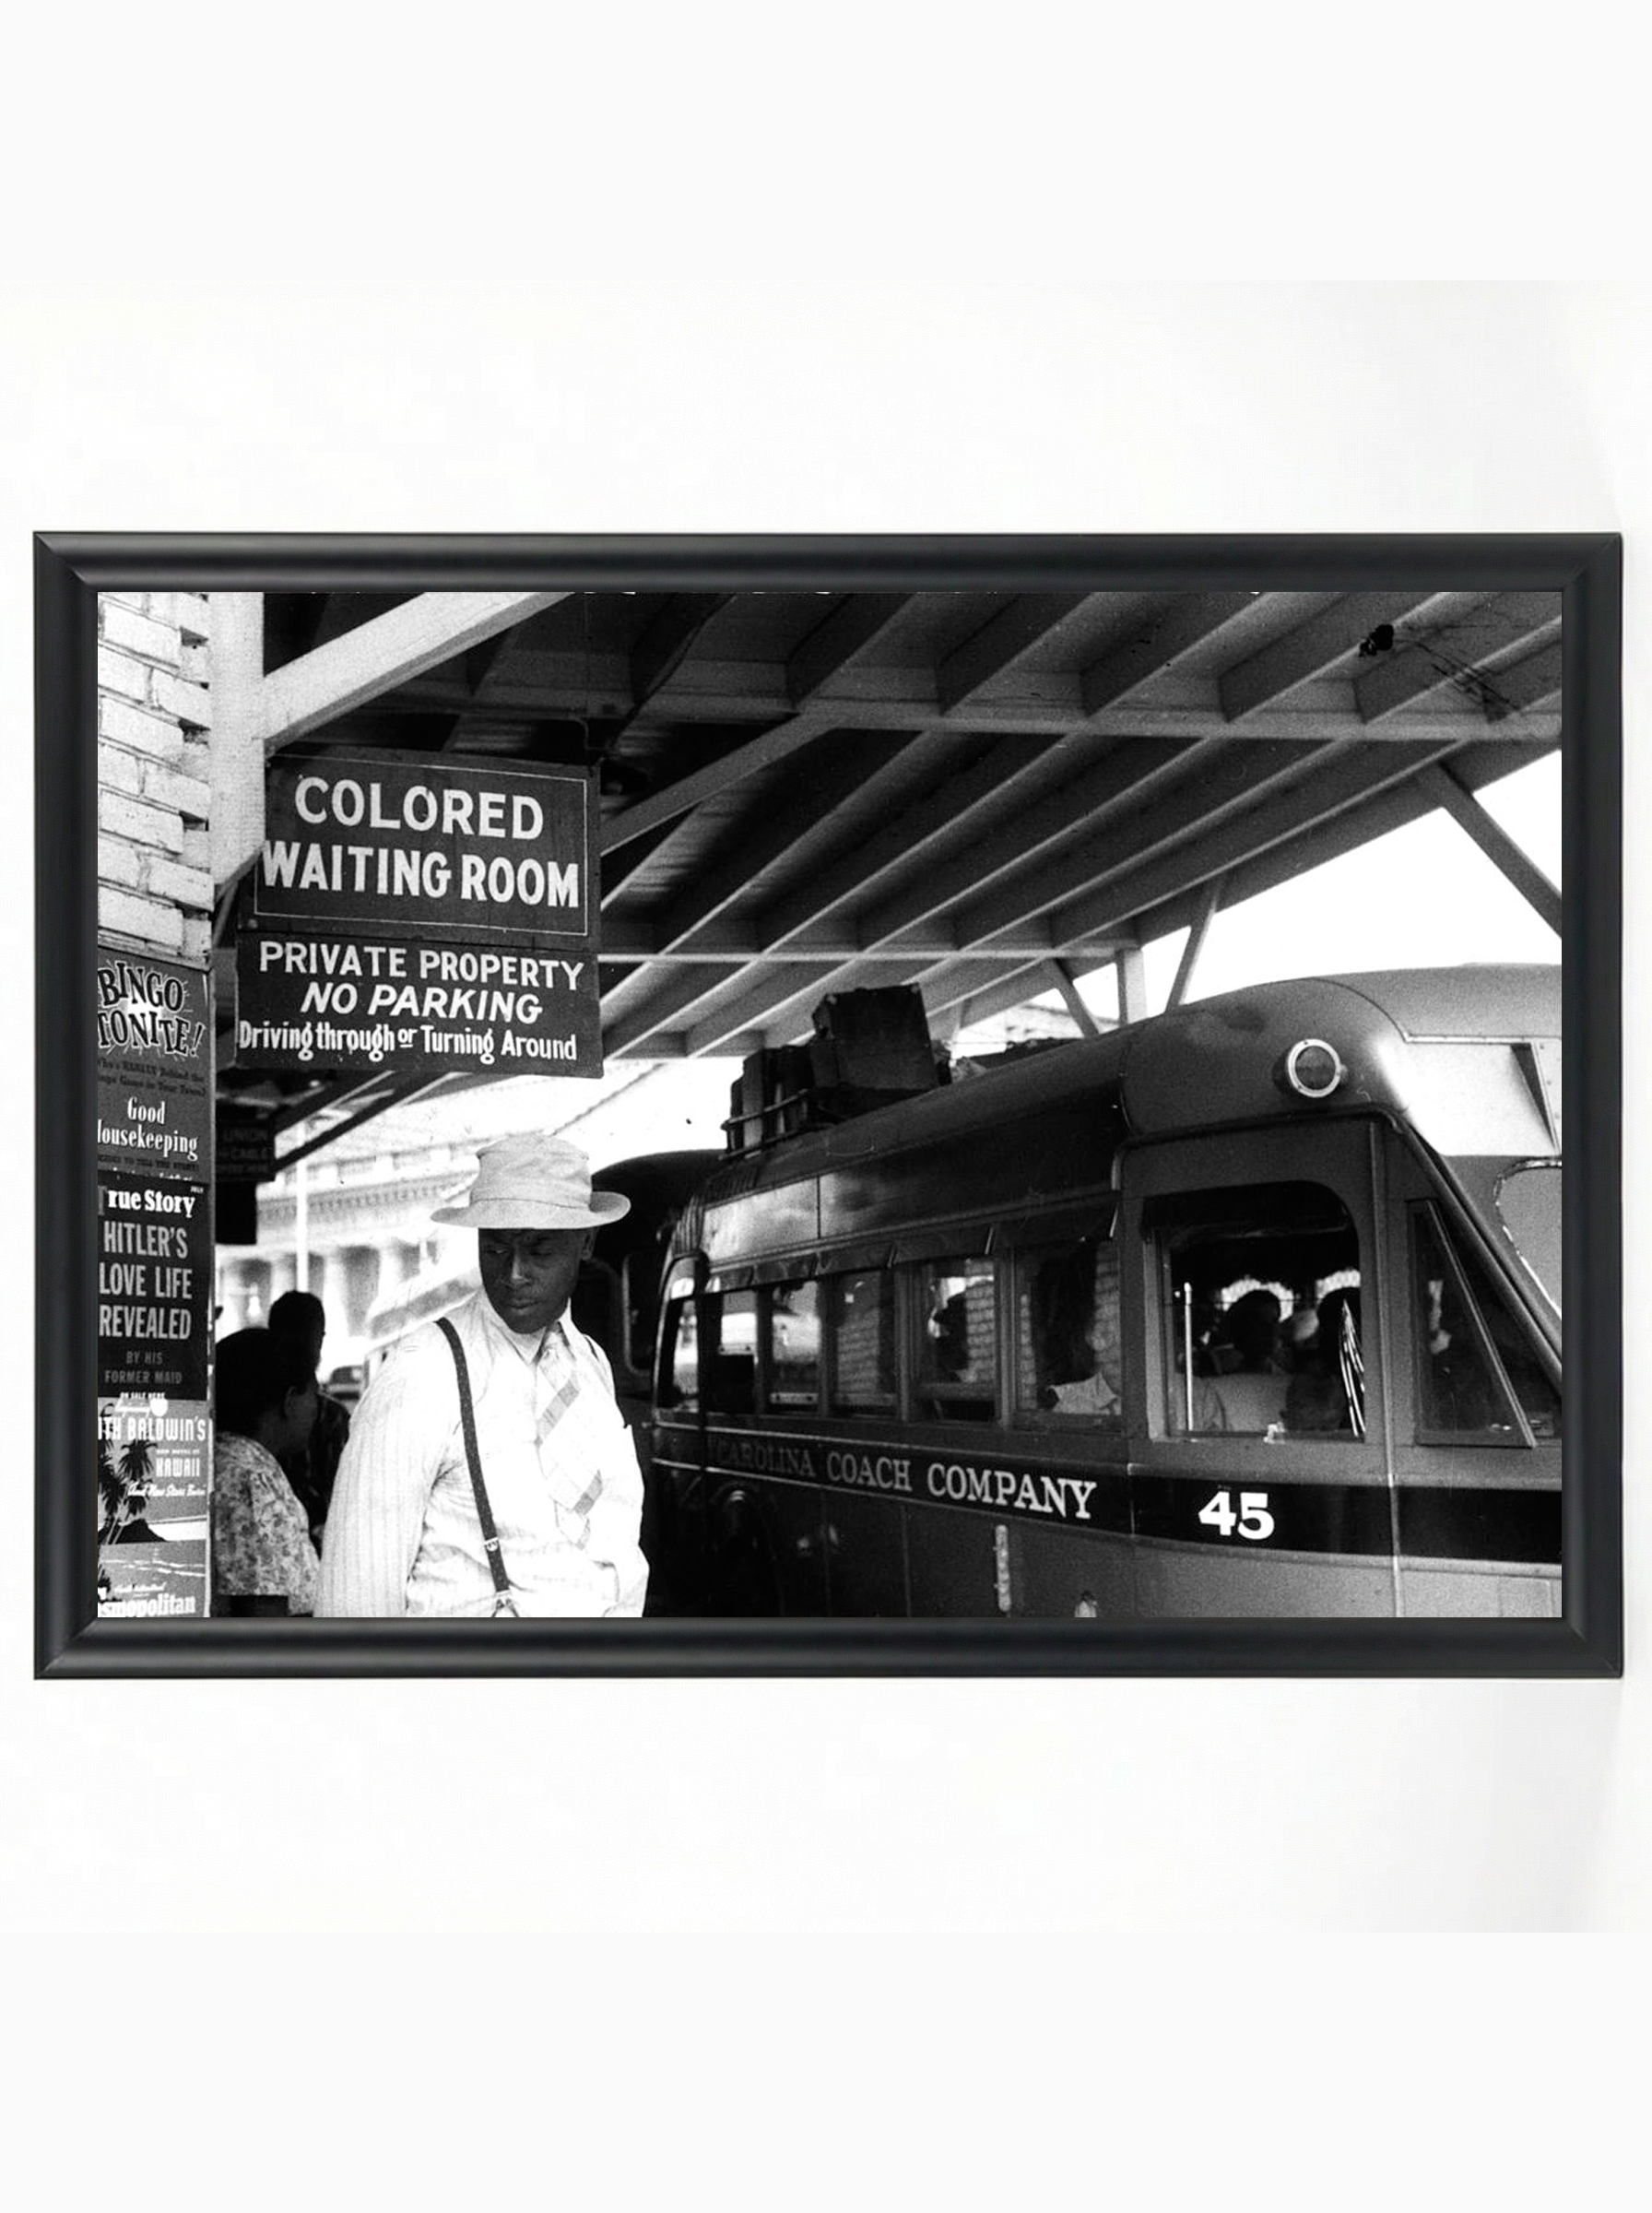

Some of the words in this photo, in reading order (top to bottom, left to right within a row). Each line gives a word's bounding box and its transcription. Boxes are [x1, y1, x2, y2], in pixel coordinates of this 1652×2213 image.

[294, 775, 544, 840] COLORED
[262, 840, 452, 898] WAITING
[460, 854, 579, 908] ROOM
[259, 941, 407, 977] PRIVATE
[419, 949, 584, 990] PROPERTY
[98, 960, 185, 1012] BINGO
[300, 982, 358, 1013] NO
[368, 984, 543, 1024] PARKING
[98, 1009, 206, 1057] TONITE!
[239, 1021, 313, 1061] Driving
[317, 1023, 395, 1062] through
[397, 1027, 418, 1048] or
[420, 1025, 495, 1065] Turning
[501, 1035, 577, 1060] Around
[127, 1096, 166, 1124] Good
[144, 1189, 195, 1218] Story
[103, 1220, 188, 1259] HITLER'S
[99, 1261, 147, 1296] LOVE
[155, 1266, 193, 1299] LIFE
[99, 1304, 193, 1340] REVEALED
[104, 1370, 149, 1384] FORMER
[154, 1371, 183, 1384] MAID
[126, 1351, 139, 1365] BY
[145, 1352, 163, 1365] HIS
[127, 1415, 206, 1441] BALDWIN'S
[155, 1457, 200, 1477] HAWAII
[716, 1438, 816, 1477] CAROLINA
[826, 1450, 913, 1492] COACH
[926, 1462, 1097, 1521] COMPANY
[1198, 1491, 1275, 1540] 45
